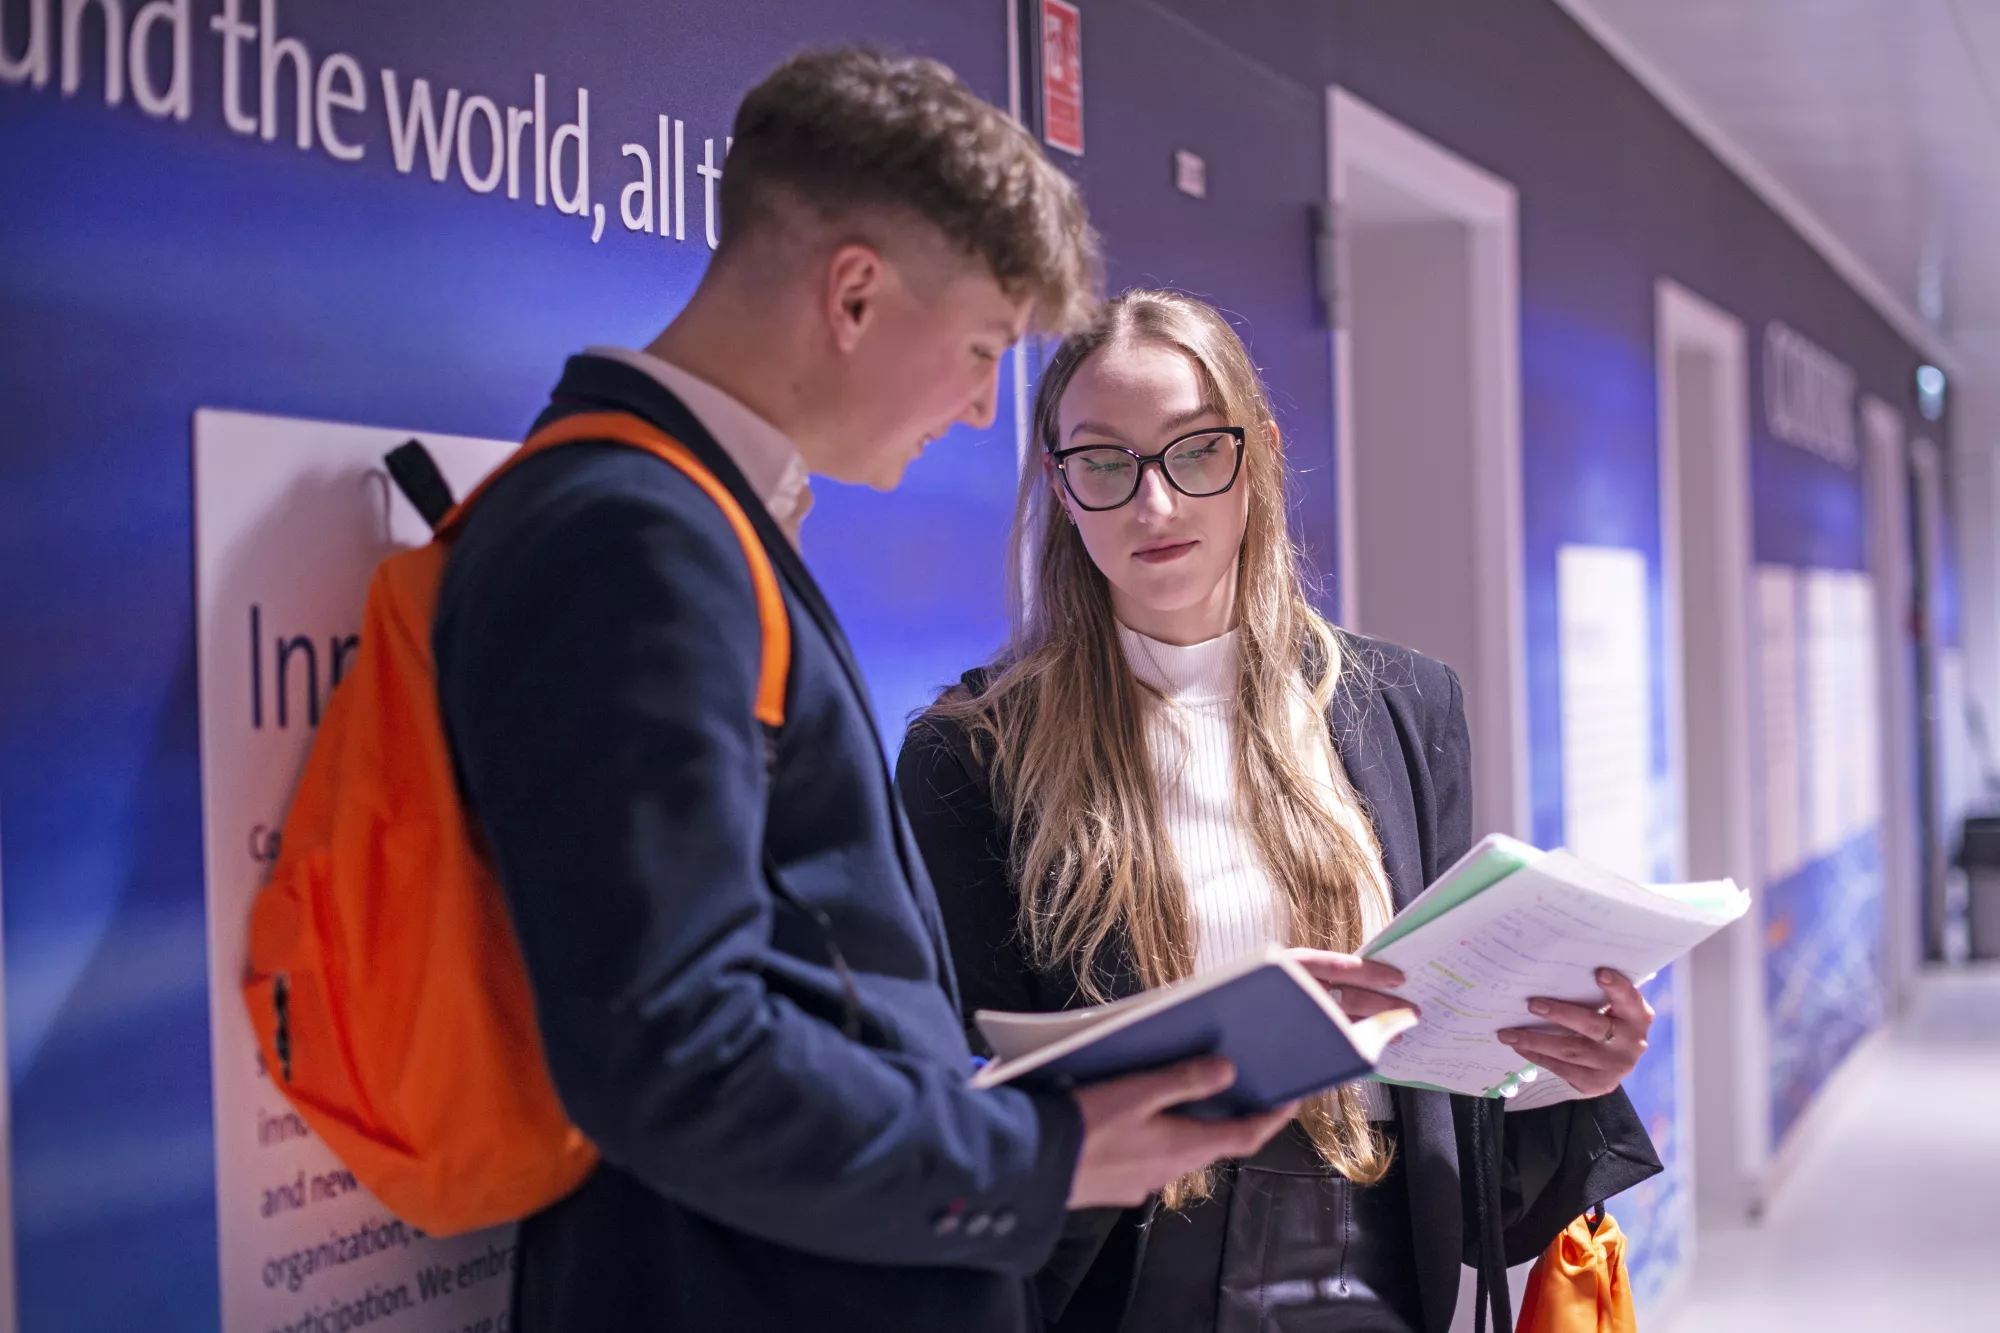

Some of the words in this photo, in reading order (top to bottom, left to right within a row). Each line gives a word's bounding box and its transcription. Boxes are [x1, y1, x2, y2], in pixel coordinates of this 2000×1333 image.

[211, 0, 365, 161] the
[381, 70, 606, 244] world,
[620, 114, 685, 241] all
[696, 136, 734, 251] t
[260, 1170, 305, 1218] and
[261, 1219, 411, 1292] organization,
[269, 1282, 415, 1333] articipation.
[418, 1262, 452, 1303] We
